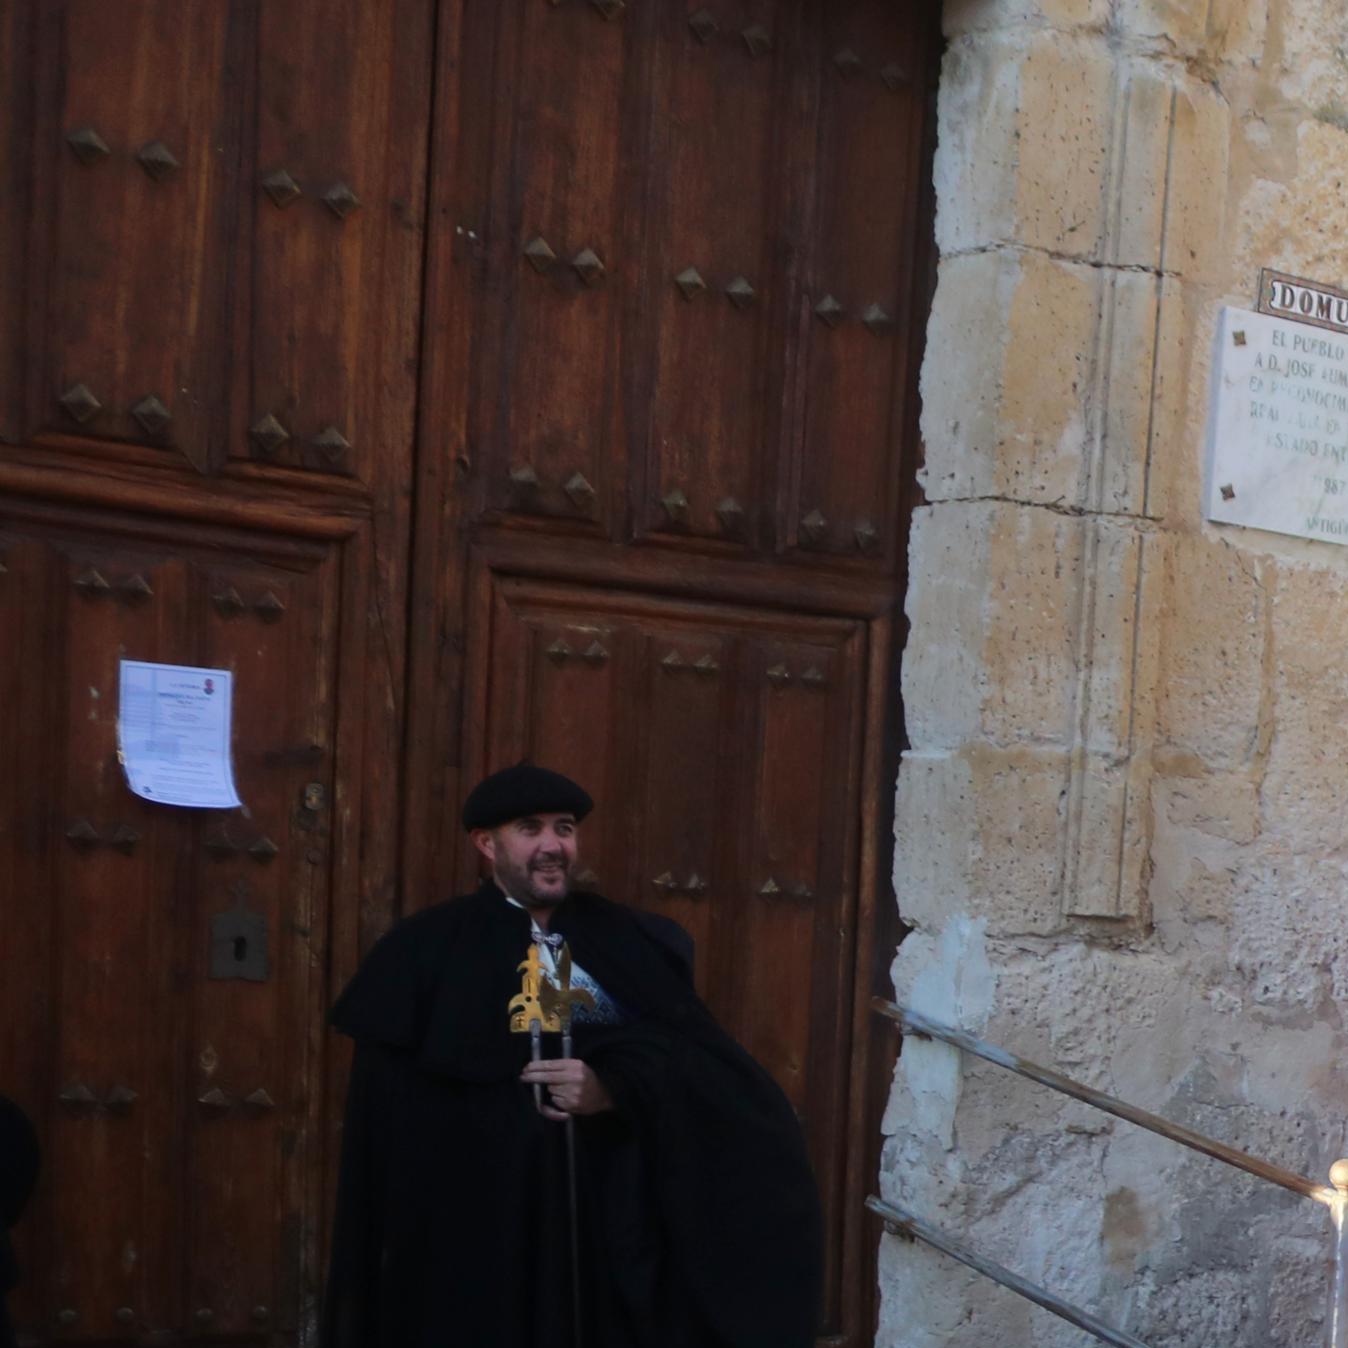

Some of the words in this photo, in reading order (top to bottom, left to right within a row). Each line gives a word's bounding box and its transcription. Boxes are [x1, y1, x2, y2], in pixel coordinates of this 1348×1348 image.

[1272, 329, 1286, 347] EL
[1293, 334, 1344, 360] PUEBLO
[1254, 352, 1262, 368] A
